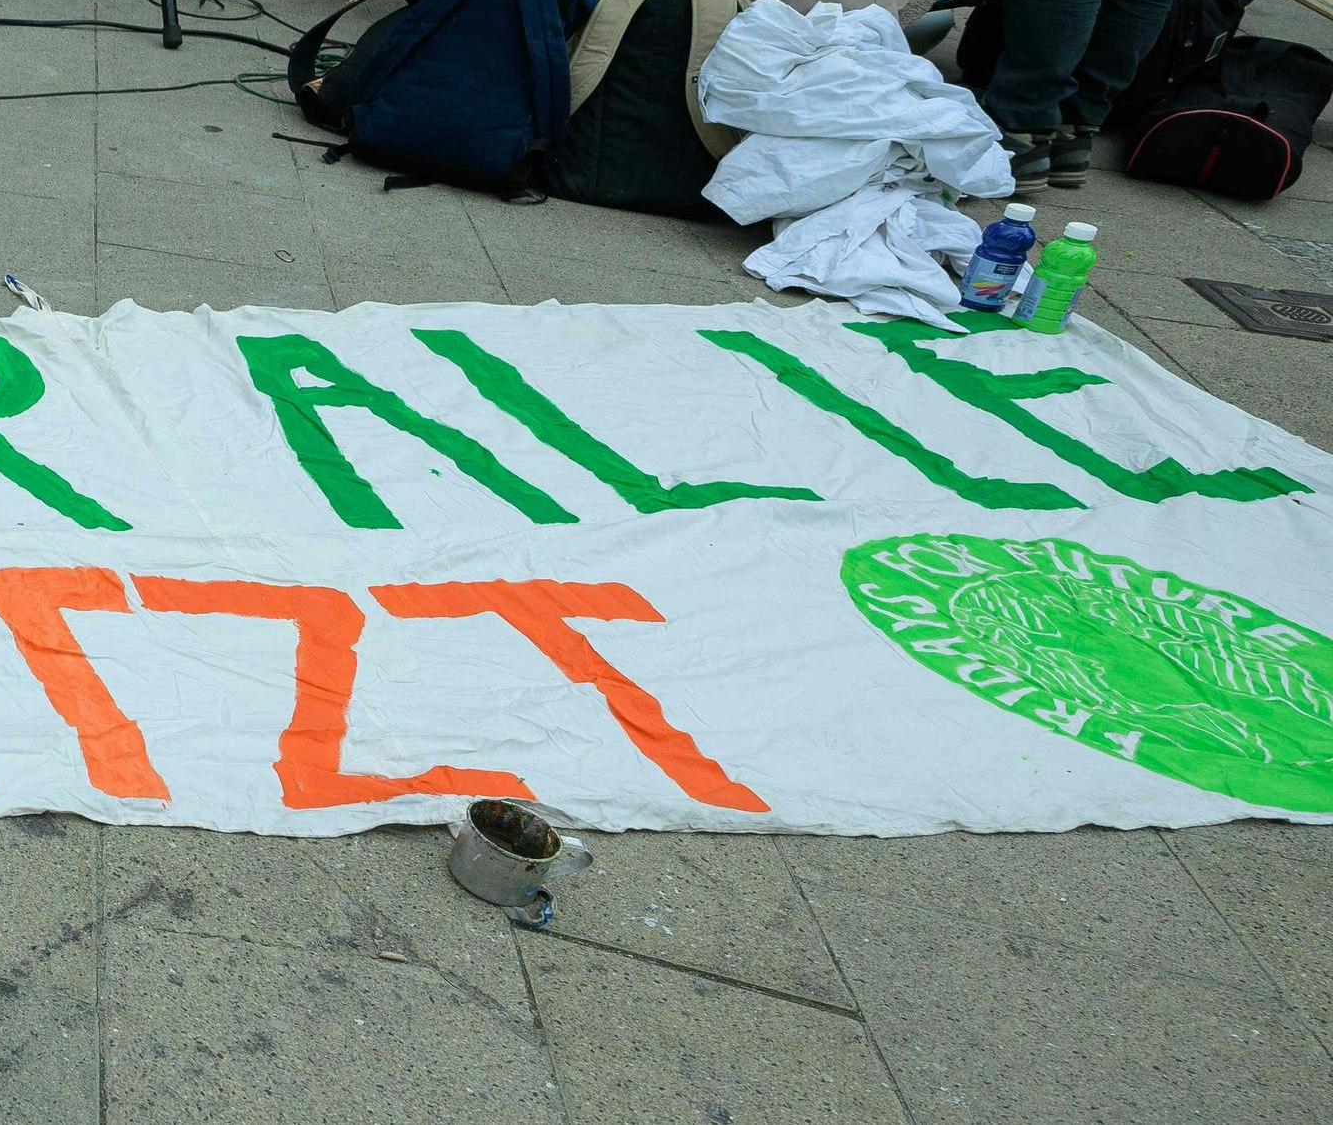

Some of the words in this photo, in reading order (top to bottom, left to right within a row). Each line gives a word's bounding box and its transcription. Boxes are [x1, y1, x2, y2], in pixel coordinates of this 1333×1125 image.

[237, 312, 1316, 530] ALLE
[871, 540, 1011, 590] FOR
[1002, 541, 1318, 647] FUTURE
